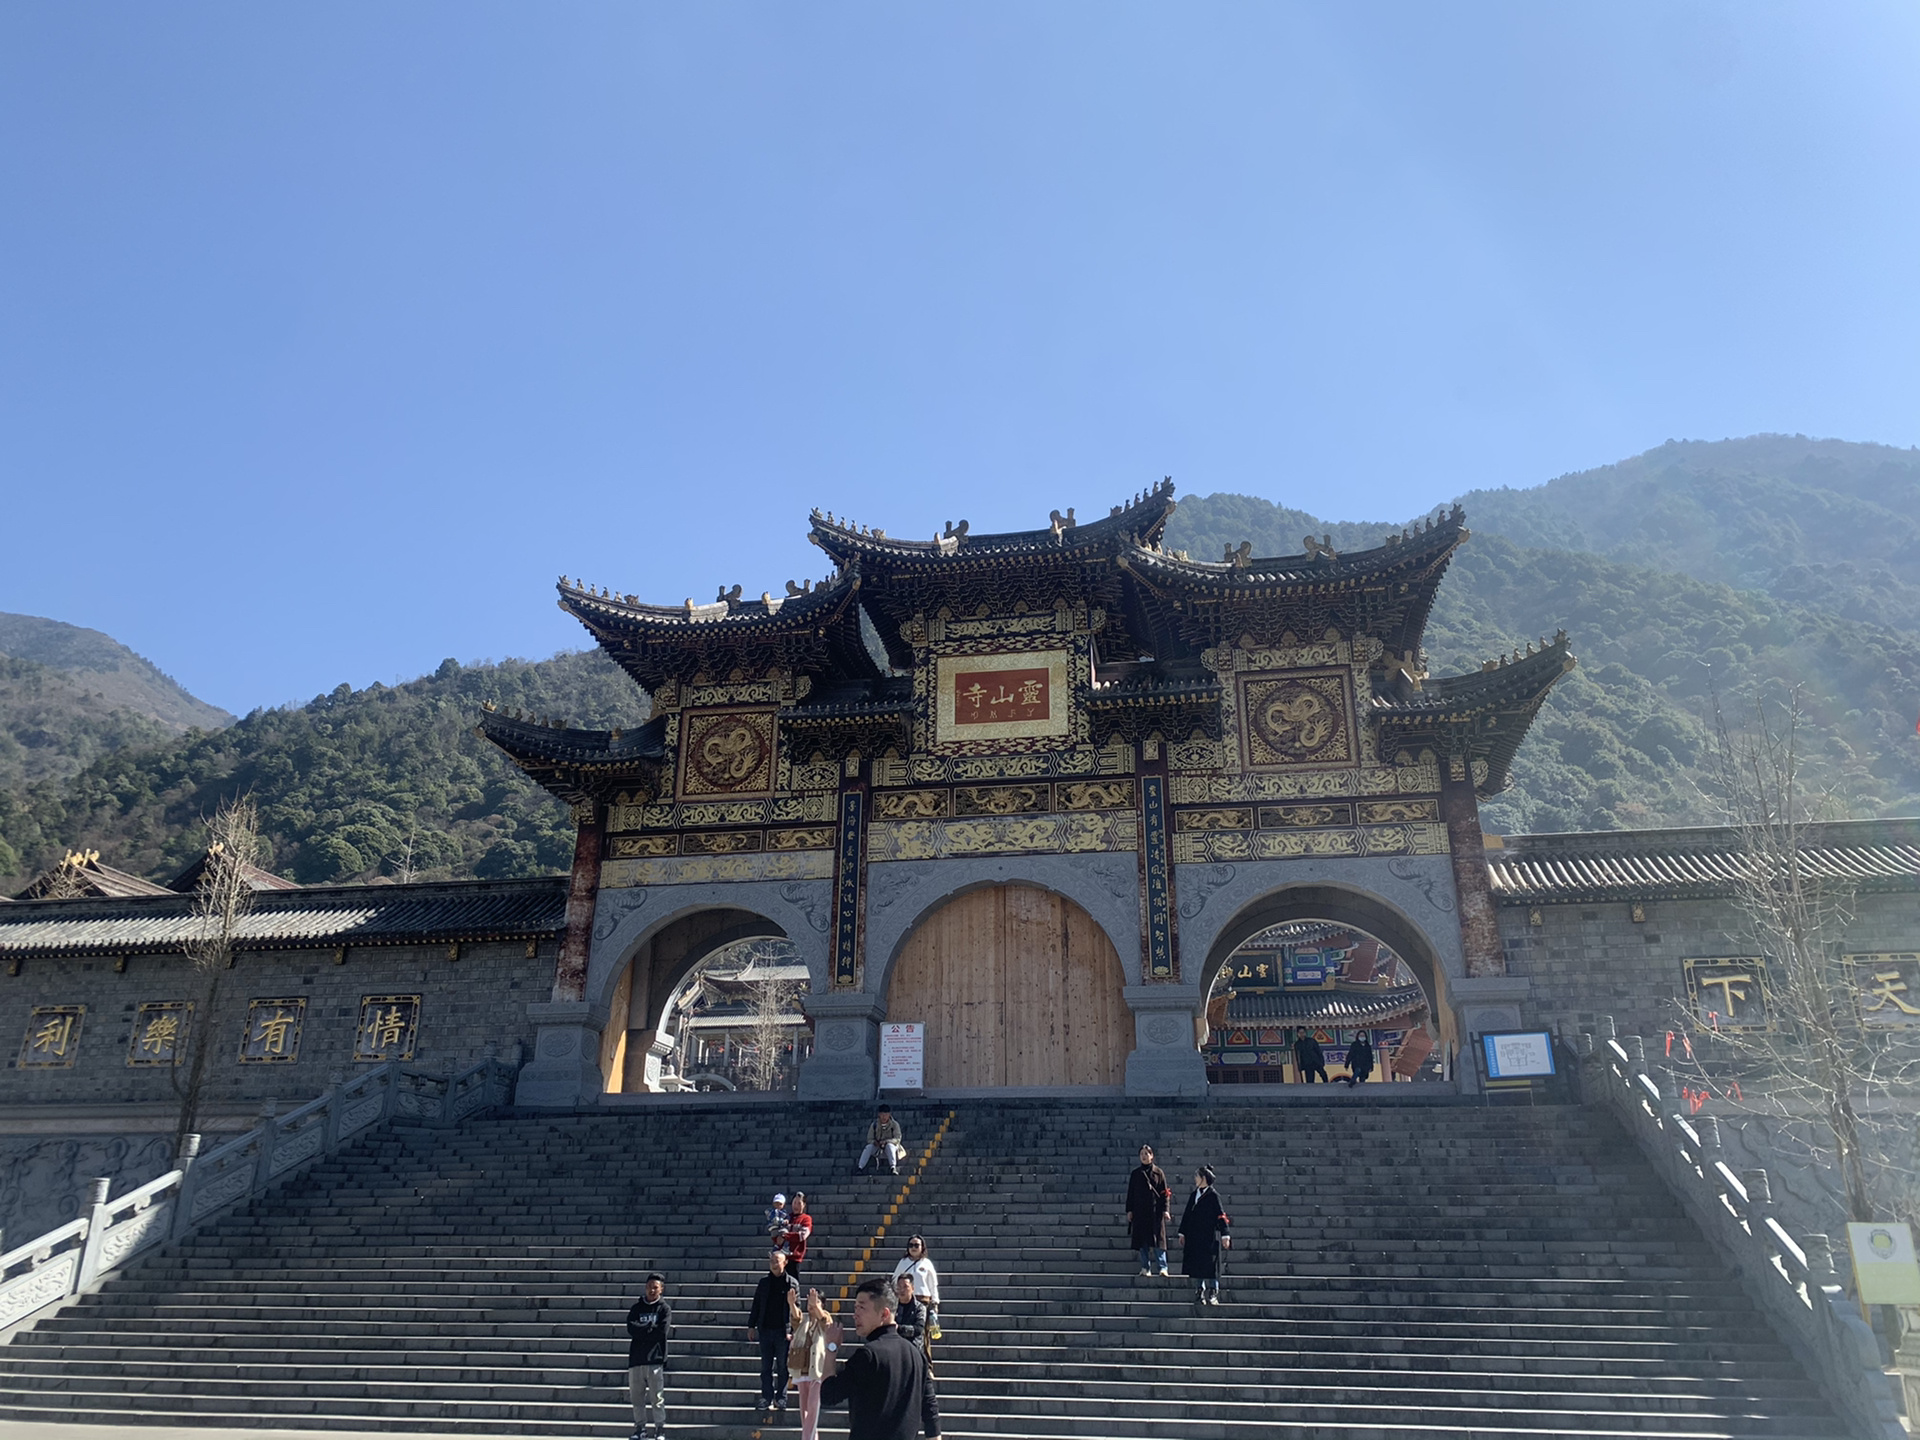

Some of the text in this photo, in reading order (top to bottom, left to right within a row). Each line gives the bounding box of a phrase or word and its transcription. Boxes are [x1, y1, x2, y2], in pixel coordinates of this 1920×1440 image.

[1702, 975, 1751, 1017] 下
[34, 1016, 73, 1055] 利
[258, 1010, 294, 1053] 有
[367, 1006, 405, 1050] 情
